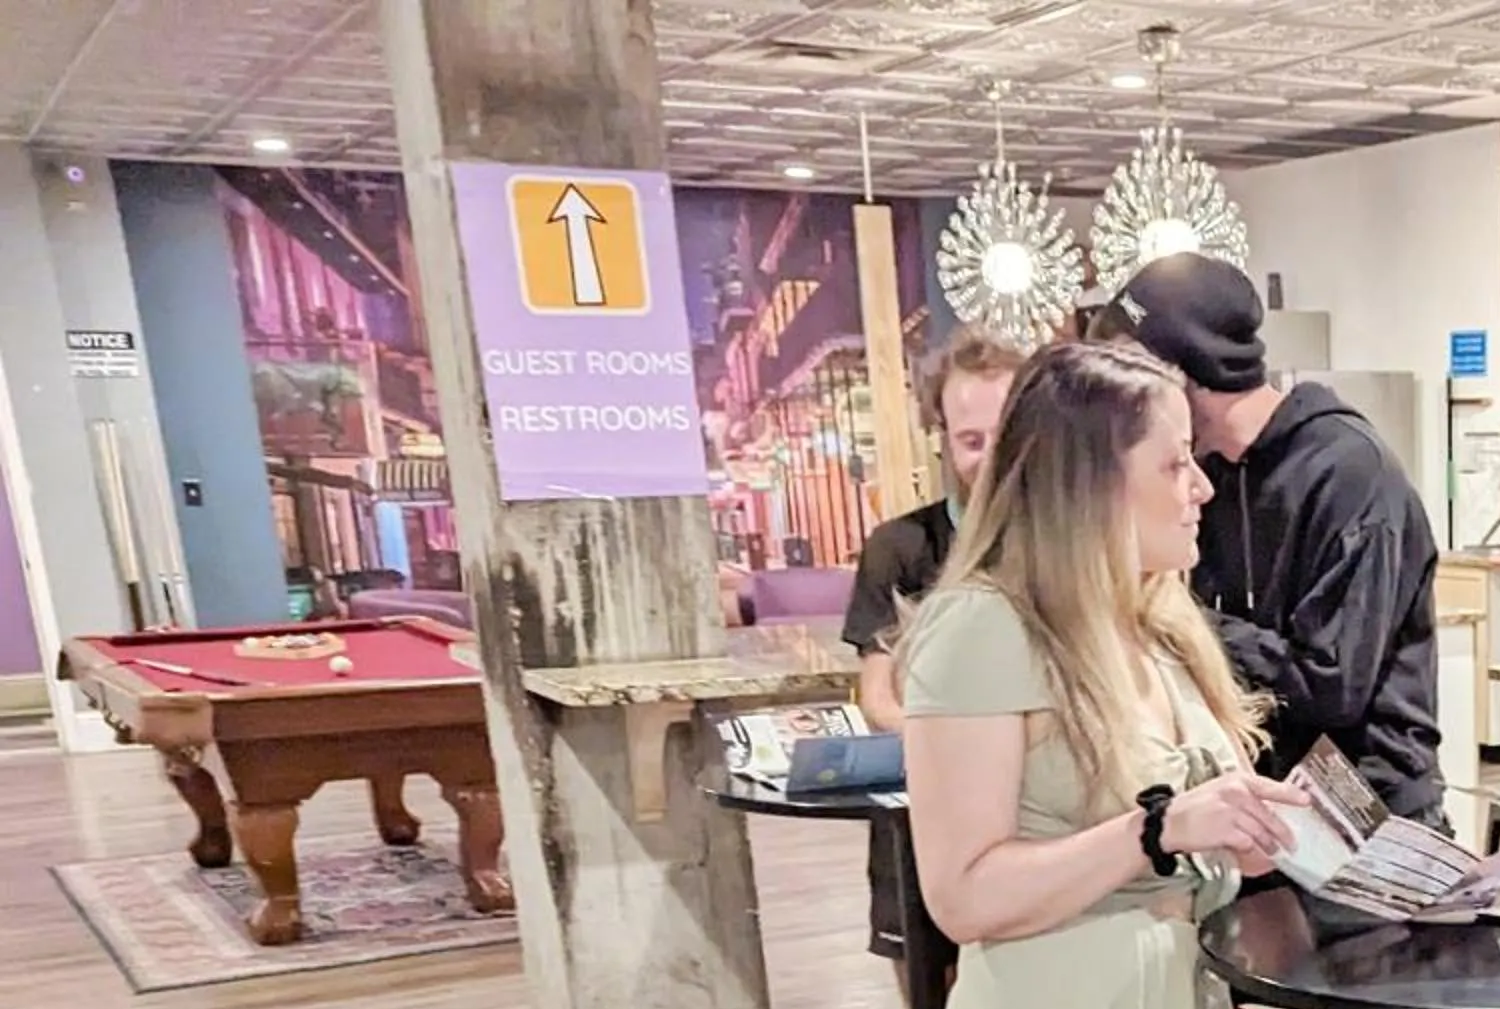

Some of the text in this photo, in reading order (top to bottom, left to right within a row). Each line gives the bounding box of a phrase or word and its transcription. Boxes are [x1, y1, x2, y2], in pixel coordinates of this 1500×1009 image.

[68, 333, 129, 348] NOTICE
[484, 350, 691, 375] GUEST ROOMS
[501, 405, 690, 432] RESTROOMS
